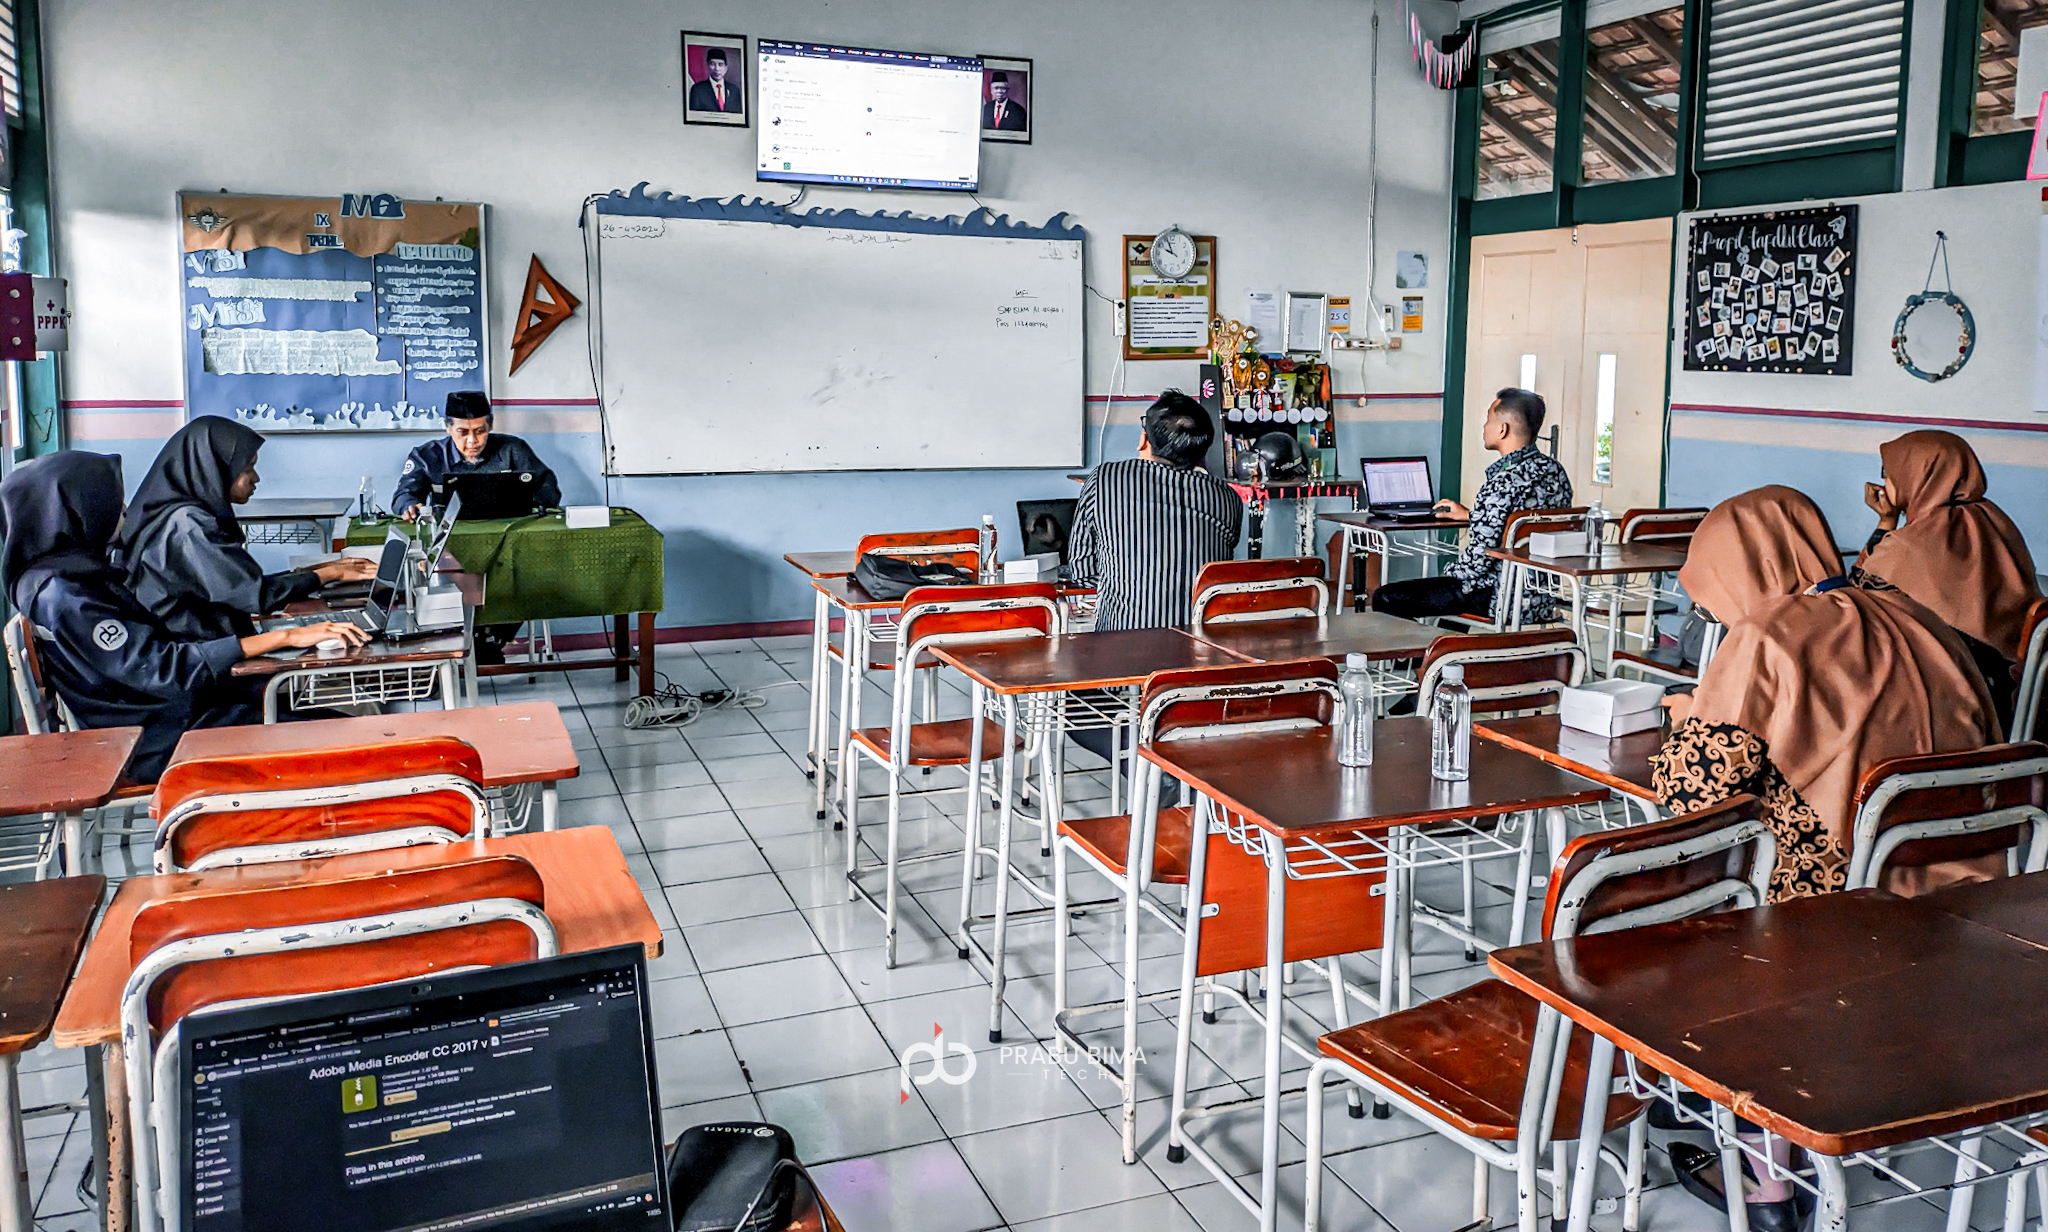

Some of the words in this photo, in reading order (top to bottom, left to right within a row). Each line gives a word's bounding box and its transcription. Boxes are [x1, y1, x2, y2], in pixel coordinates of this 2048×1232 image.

[37, 316, 66, 330] PPPK
[309, 1066, 346, 1080] Adobe
[349, 1058, 382, 1073] Media
[385, 1050, 429, 1067] Encoder
[432, 1046, 450, 1058] CC
[452, 1040, 478, 1054] 2017
[704, 1126, 752, 1134] SEAGATE
